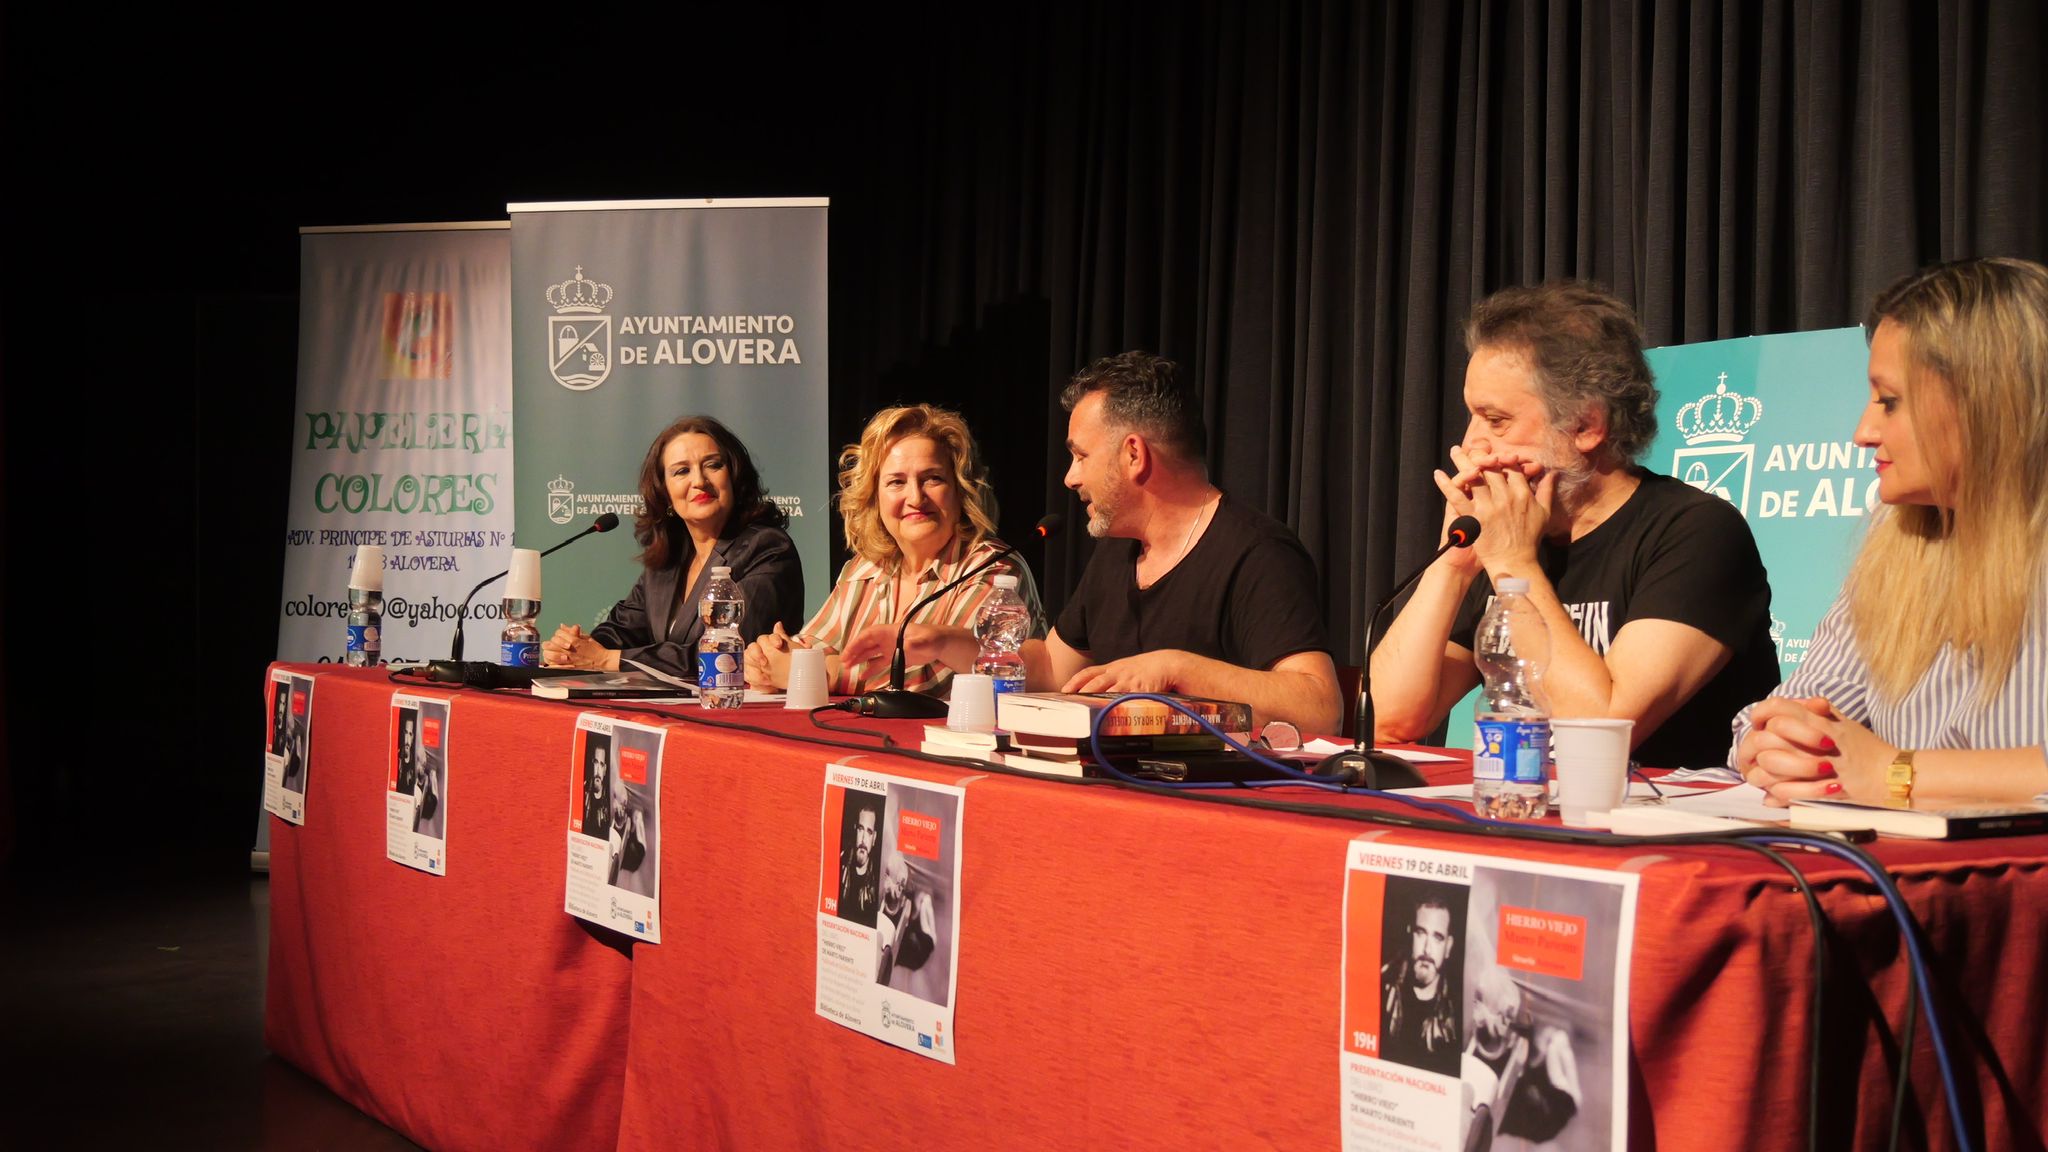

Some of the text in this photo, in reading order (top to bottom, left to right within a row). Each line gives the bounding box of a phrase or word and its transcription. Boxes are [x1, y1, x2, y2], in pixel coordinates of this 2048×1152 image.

[619, 315, 794, 334] AYUNTAMIENTO
[620, 338, 801, 364] DE ALOVERA
[314, 472, 497, 515] COLORES
[577, 494, 645, 503] AYUNTAMIENTO
[576, 506, 588, 515] DE
[1759, 490, 1799, 518] DE
[320, 529, 387, 547] PRINCIPE
[391, 530, 412, 547] DE
[415, 530, 485, 548] ASTURIAS
[391, 556, 459, 572] ALOVERA
[1784, 653, 1798, 663] DE
[1133, 715, 1154, 726] HORAS
[832, 772, 886, 792] VIERNES 19 DE ABRIL
[1359, 852, 1469, 879] VIERNES 19 DE ABRIL
[825, 897, 837, 912] 19H
[1505, 912, 1578, 937] HIERRO VIEJO
[1353, 1031, 1377, 1052] 19H
[1350, 1062, 1447, 1096] PRESENTACIÓN NACIONAL
[1383, 1112, 1415, 1130] PARIENTE
